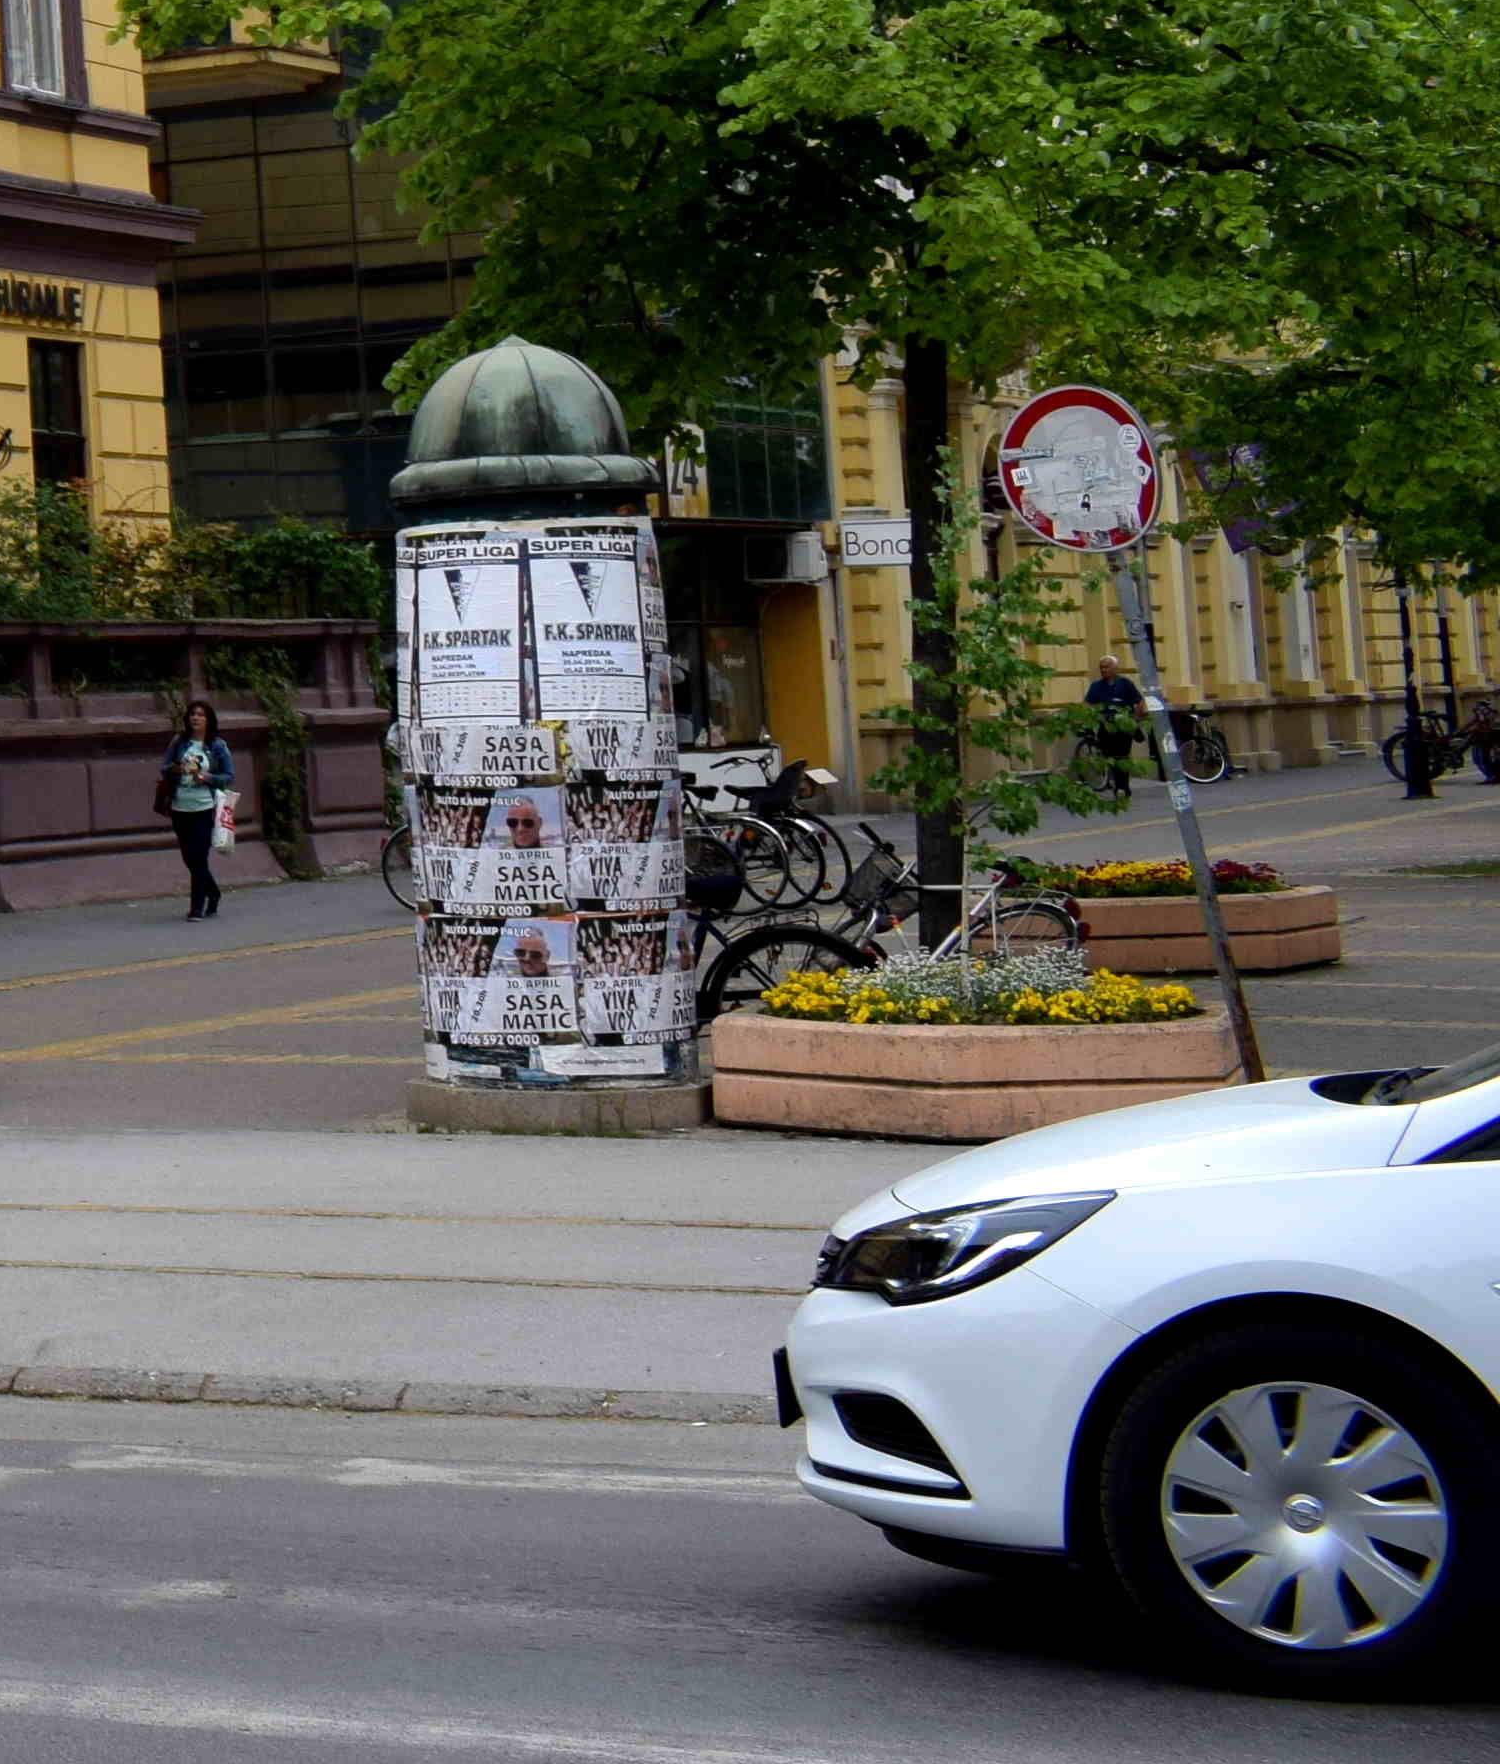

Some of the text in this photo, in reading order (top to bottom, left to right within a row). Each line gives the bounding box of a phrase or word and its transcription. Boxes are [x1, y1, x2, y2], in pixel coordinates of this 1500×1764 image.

[418, 545, 515, 562] SUPER LIGA
[530, 540, 633, 554] SUPER LIGA
[446, 628, 511, 648] SPARTAK
[545, 622, 636, 642] F.K. SPARTAK
[586, 725, 620, 748] VIVA
[591, 747, 620, 768] VOX
[463, 776, 483, 787] 592
[484, 775, 518, 787] 0000
[517, 851, 553, 860] APRIL
[601, 845, 630, 854] APRIL
[589, 856, 623, 877] VIVA
[592, 878, 620, 897] VOX
[476, 905, 497, 916] 592
[498, 905, 532, 916] 0000
[526, 978, 560, 988] APRIL
[613, 979, 643, 988] APRIL
[603, 989, 637, 1010] VIVA
[607, 1010, 637, 1031] VOX
[483, 1034, 505, 1045] 592
[508, 1034, 540, 1045] 0000
